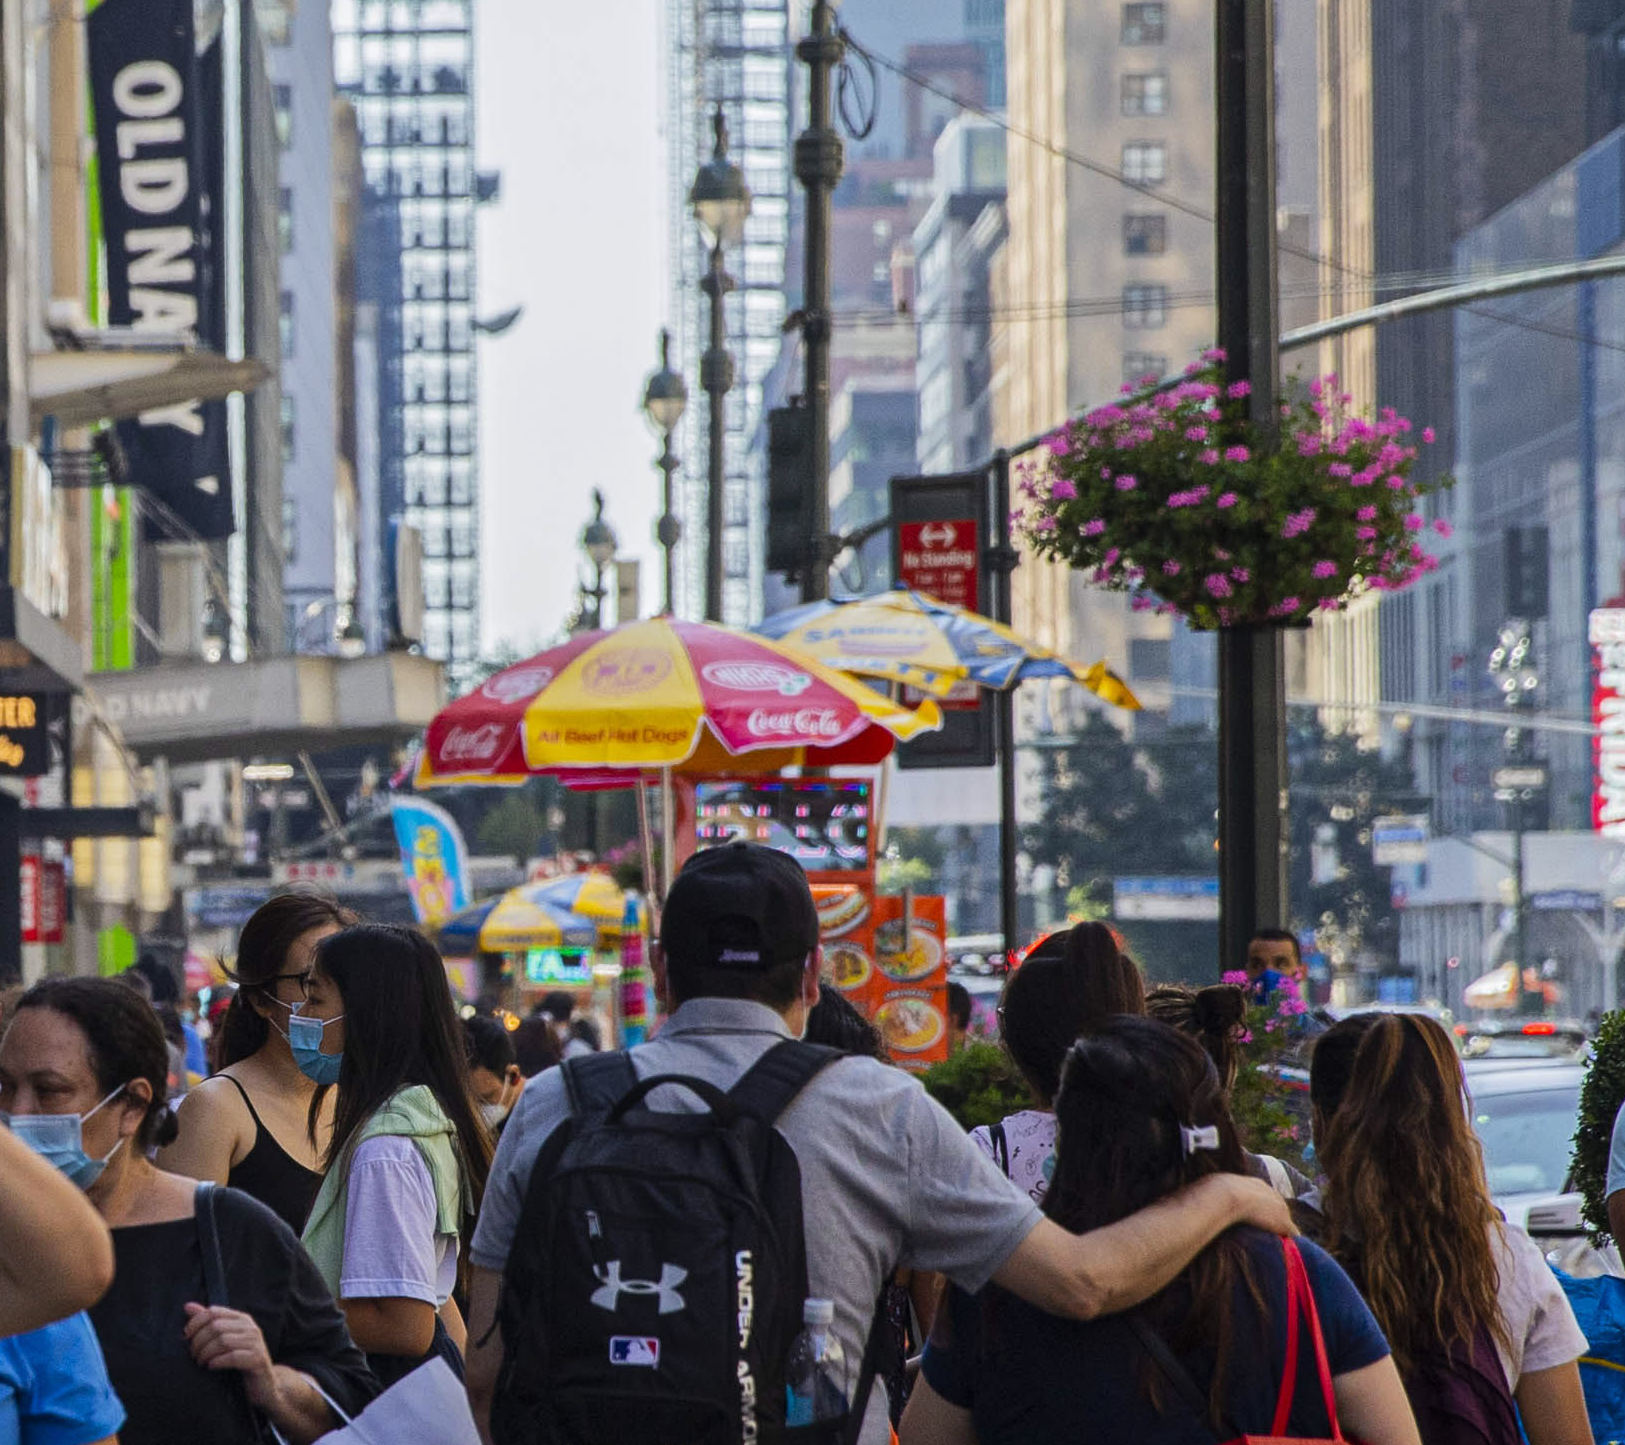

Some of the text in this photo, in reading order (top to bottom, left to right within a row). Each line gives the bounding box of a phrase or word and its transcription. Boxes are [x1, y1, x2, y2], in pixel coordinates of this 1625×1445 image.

[113, 60, 205, 436] OLD NAY
[735, 1250, 754, 1349] UNDER
